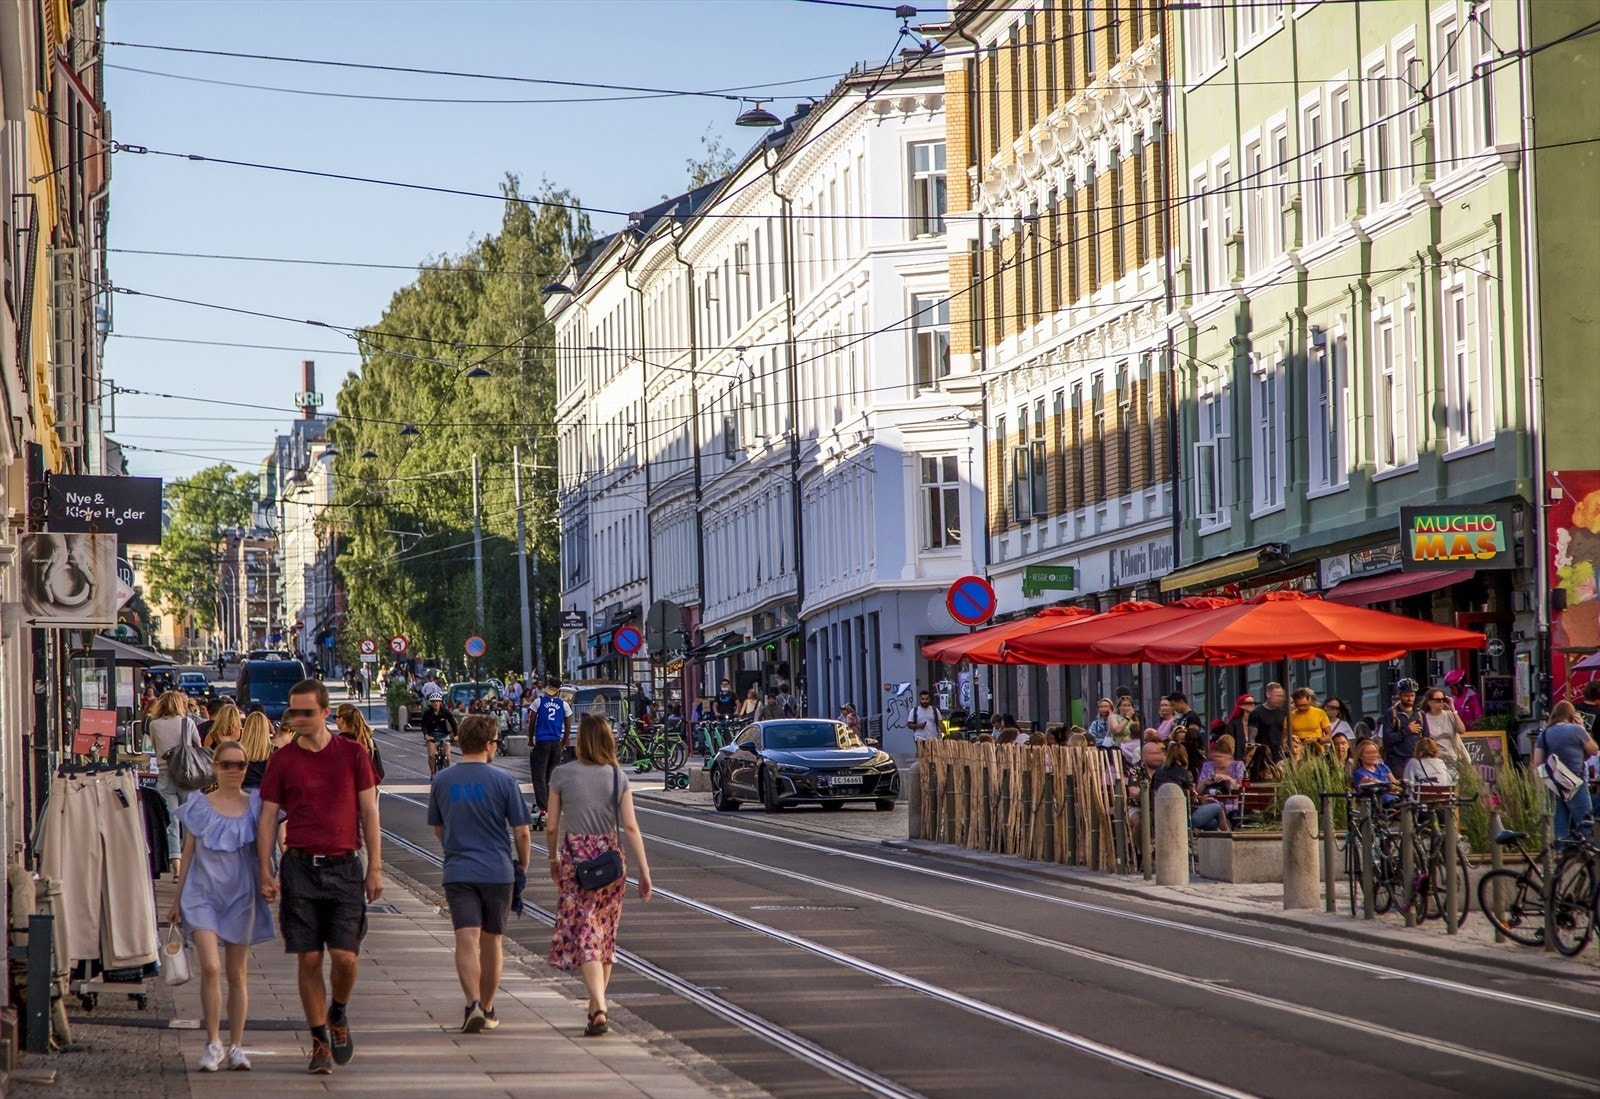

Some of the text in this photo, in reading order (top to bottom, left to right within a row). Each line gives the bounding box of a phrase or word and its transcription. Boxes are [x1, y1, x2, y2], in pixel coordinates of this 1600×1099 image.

[66, 492, 104, 506] Nye &
[1416, 515, 1496, 533] MUCHO
[1414, 533, 1497, 561] MAS
[1120, 541, 1173, 579] Velouria Vintage
[548, 707, 556, 721] 2
[1464, 741, 1482, 755] Try
